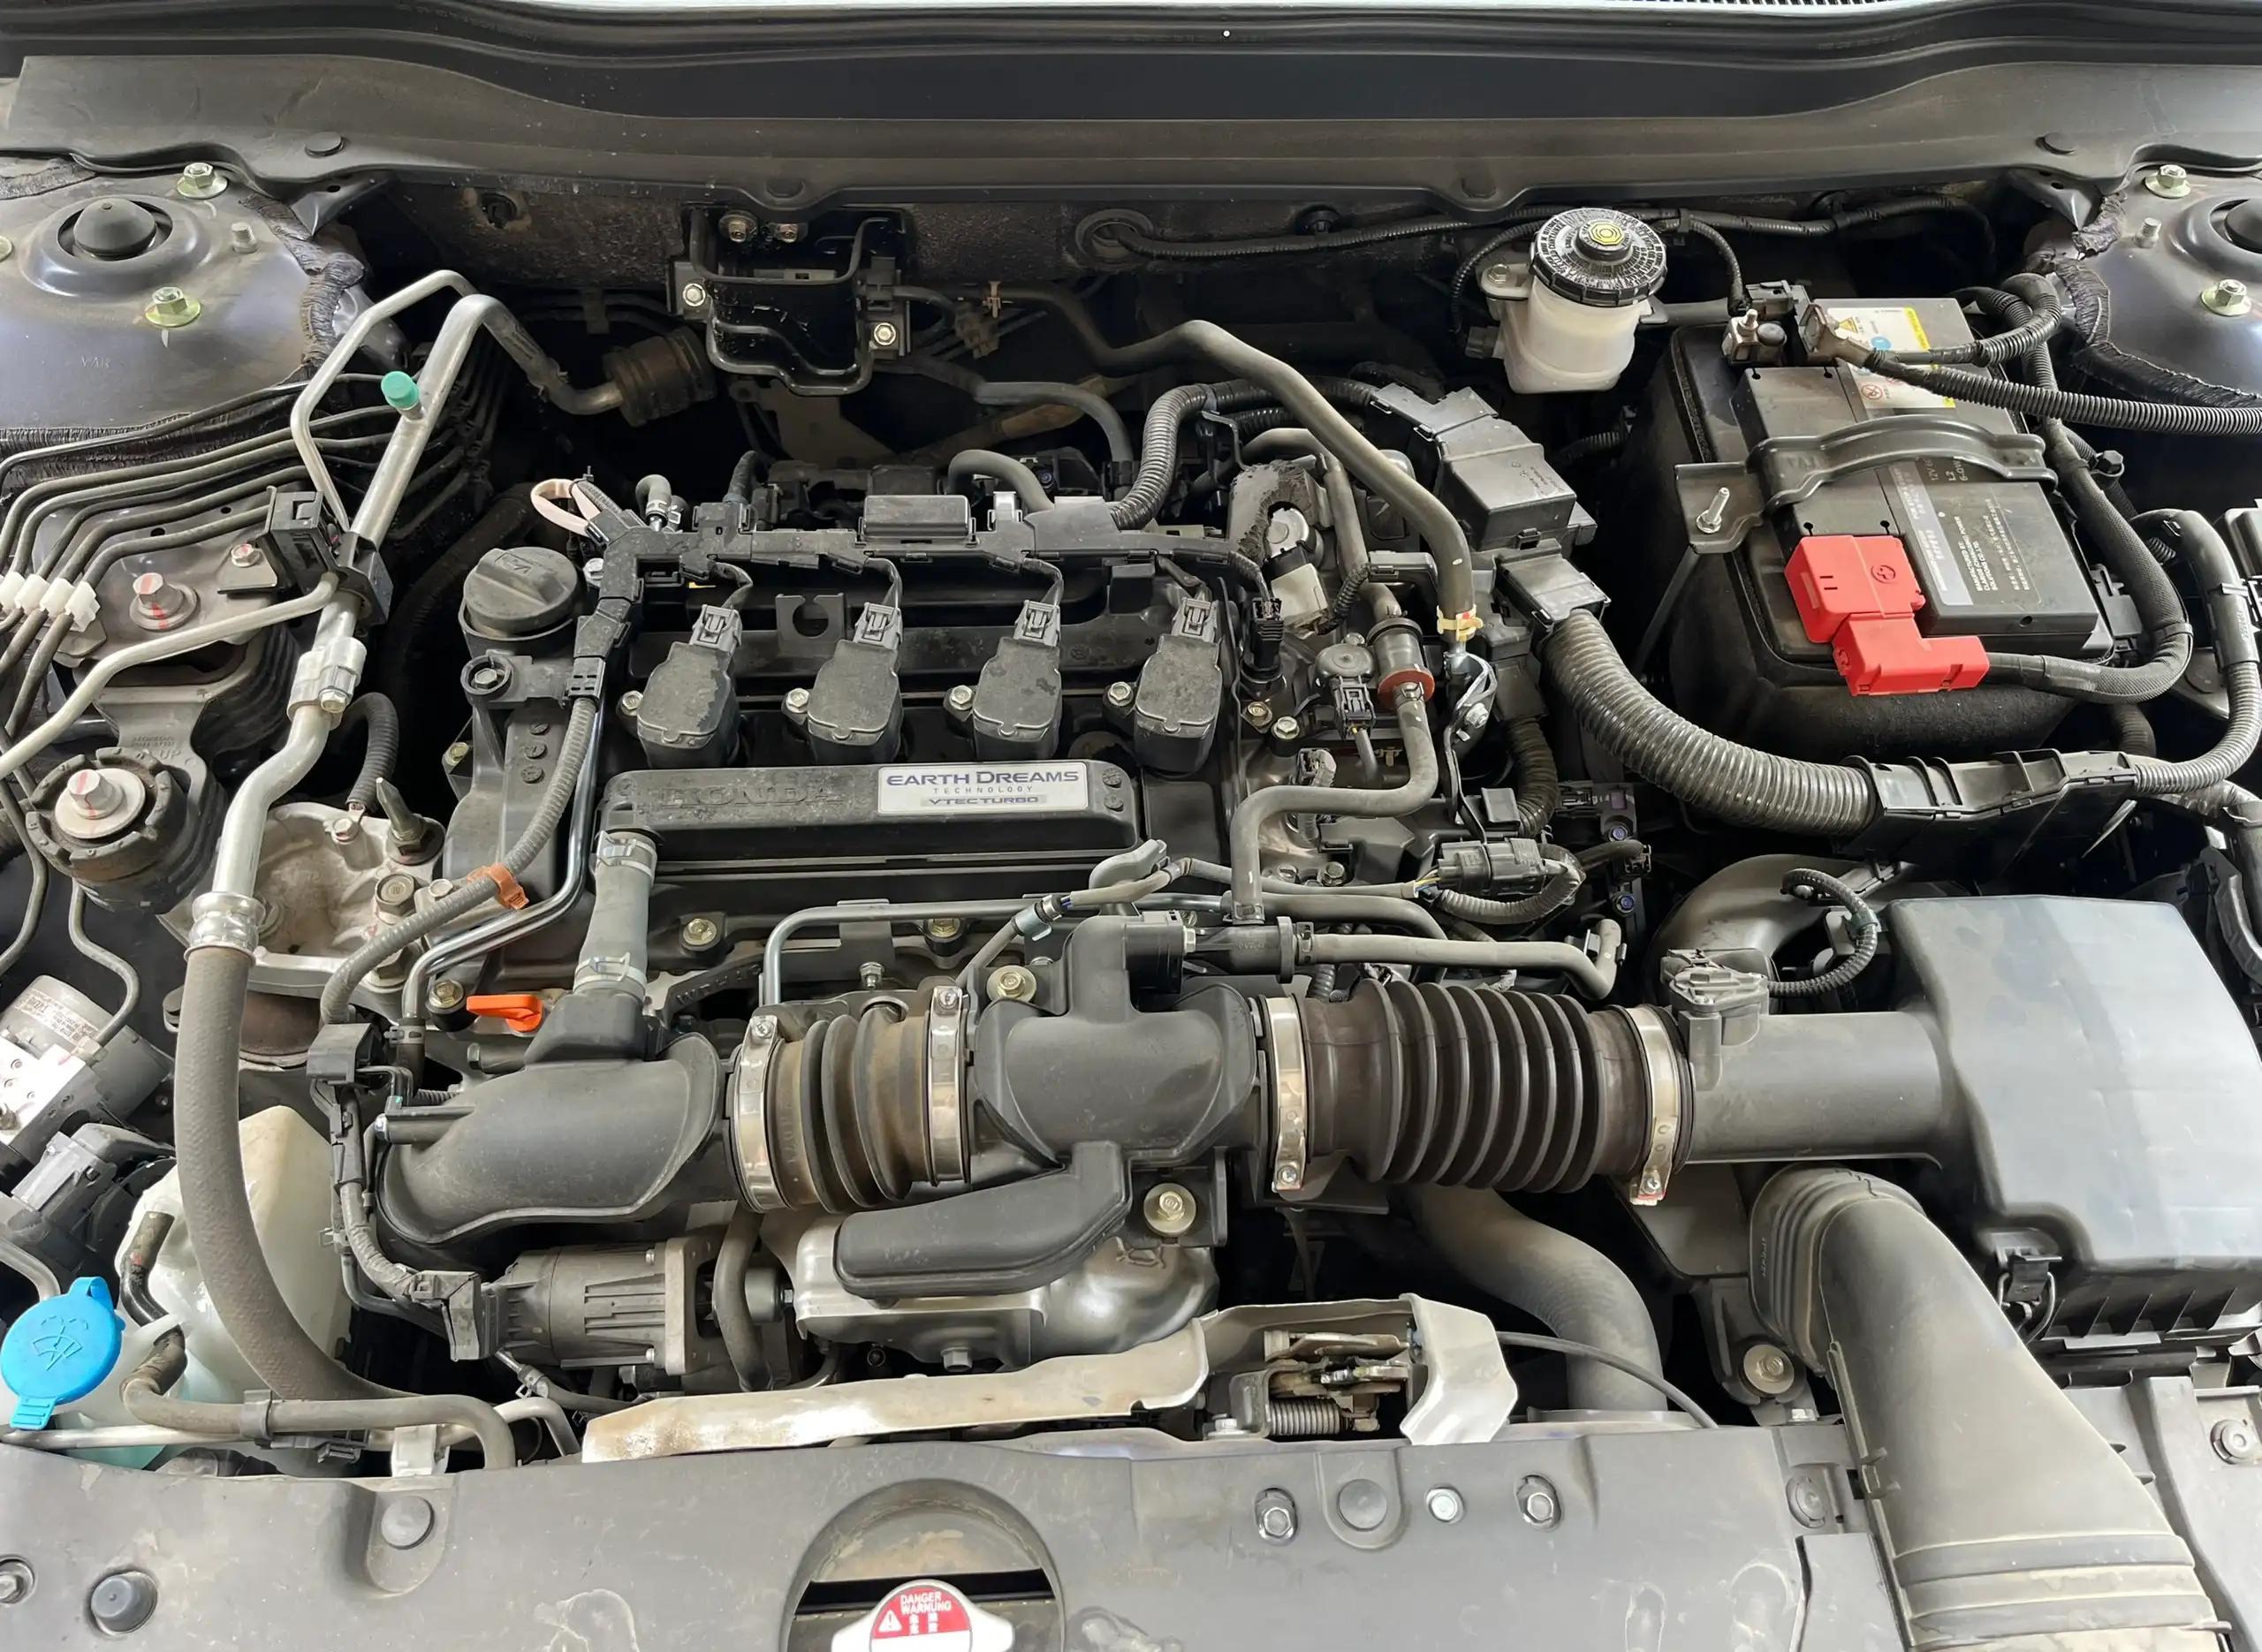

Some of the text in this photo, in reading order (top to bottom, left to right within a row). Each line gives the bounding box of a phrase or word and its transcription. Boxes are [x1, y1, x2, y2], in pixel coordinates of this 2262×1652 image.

[886, 771, 1080, 786] EARTH DREAMS
[933, 785, 1033, 794] TECHNOLOGY
[900, 1591, 942, 1604] DANGER
